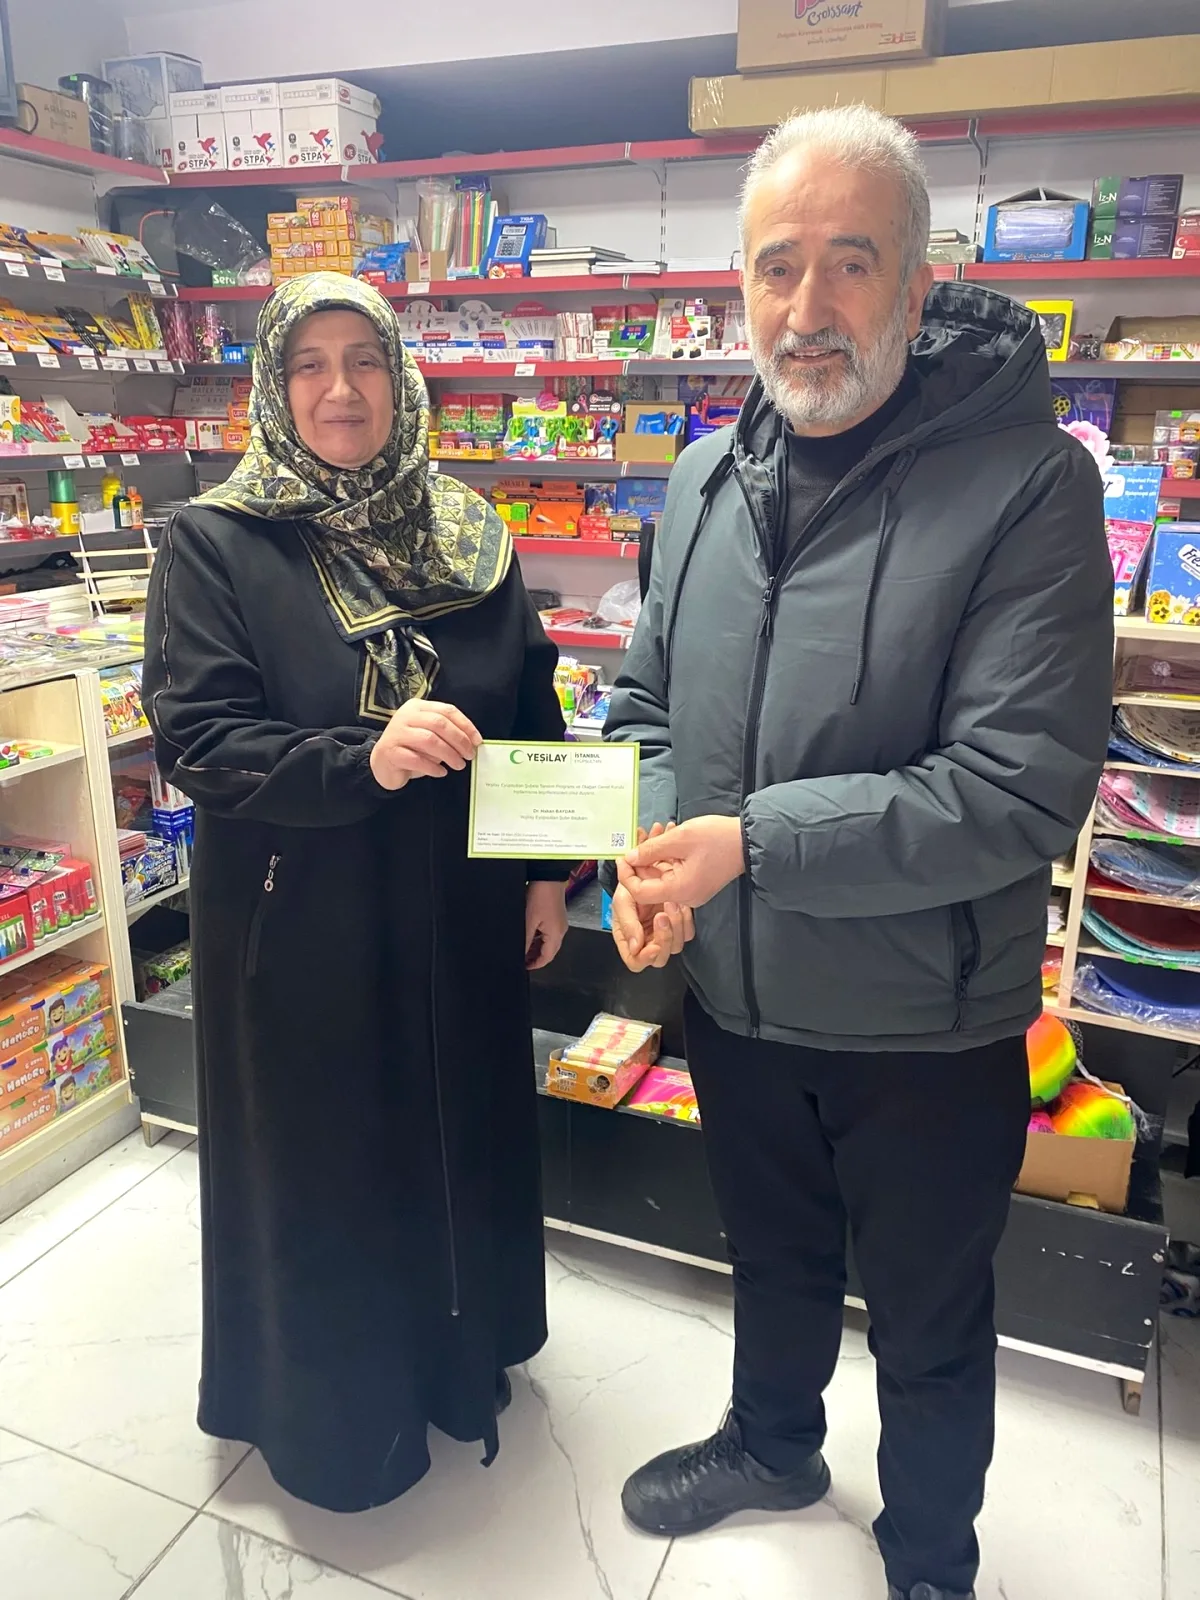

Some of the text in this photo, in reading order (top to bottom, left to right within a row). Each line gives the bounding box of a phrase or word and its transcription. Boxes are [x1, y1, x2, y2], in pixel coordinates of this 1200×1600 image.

[807, 1, 863, 26] Croissant
[244, 154, 266, 164] STPA
[300, 151, 323, 162] STPA
[188, 158, 209, 168] STPA
